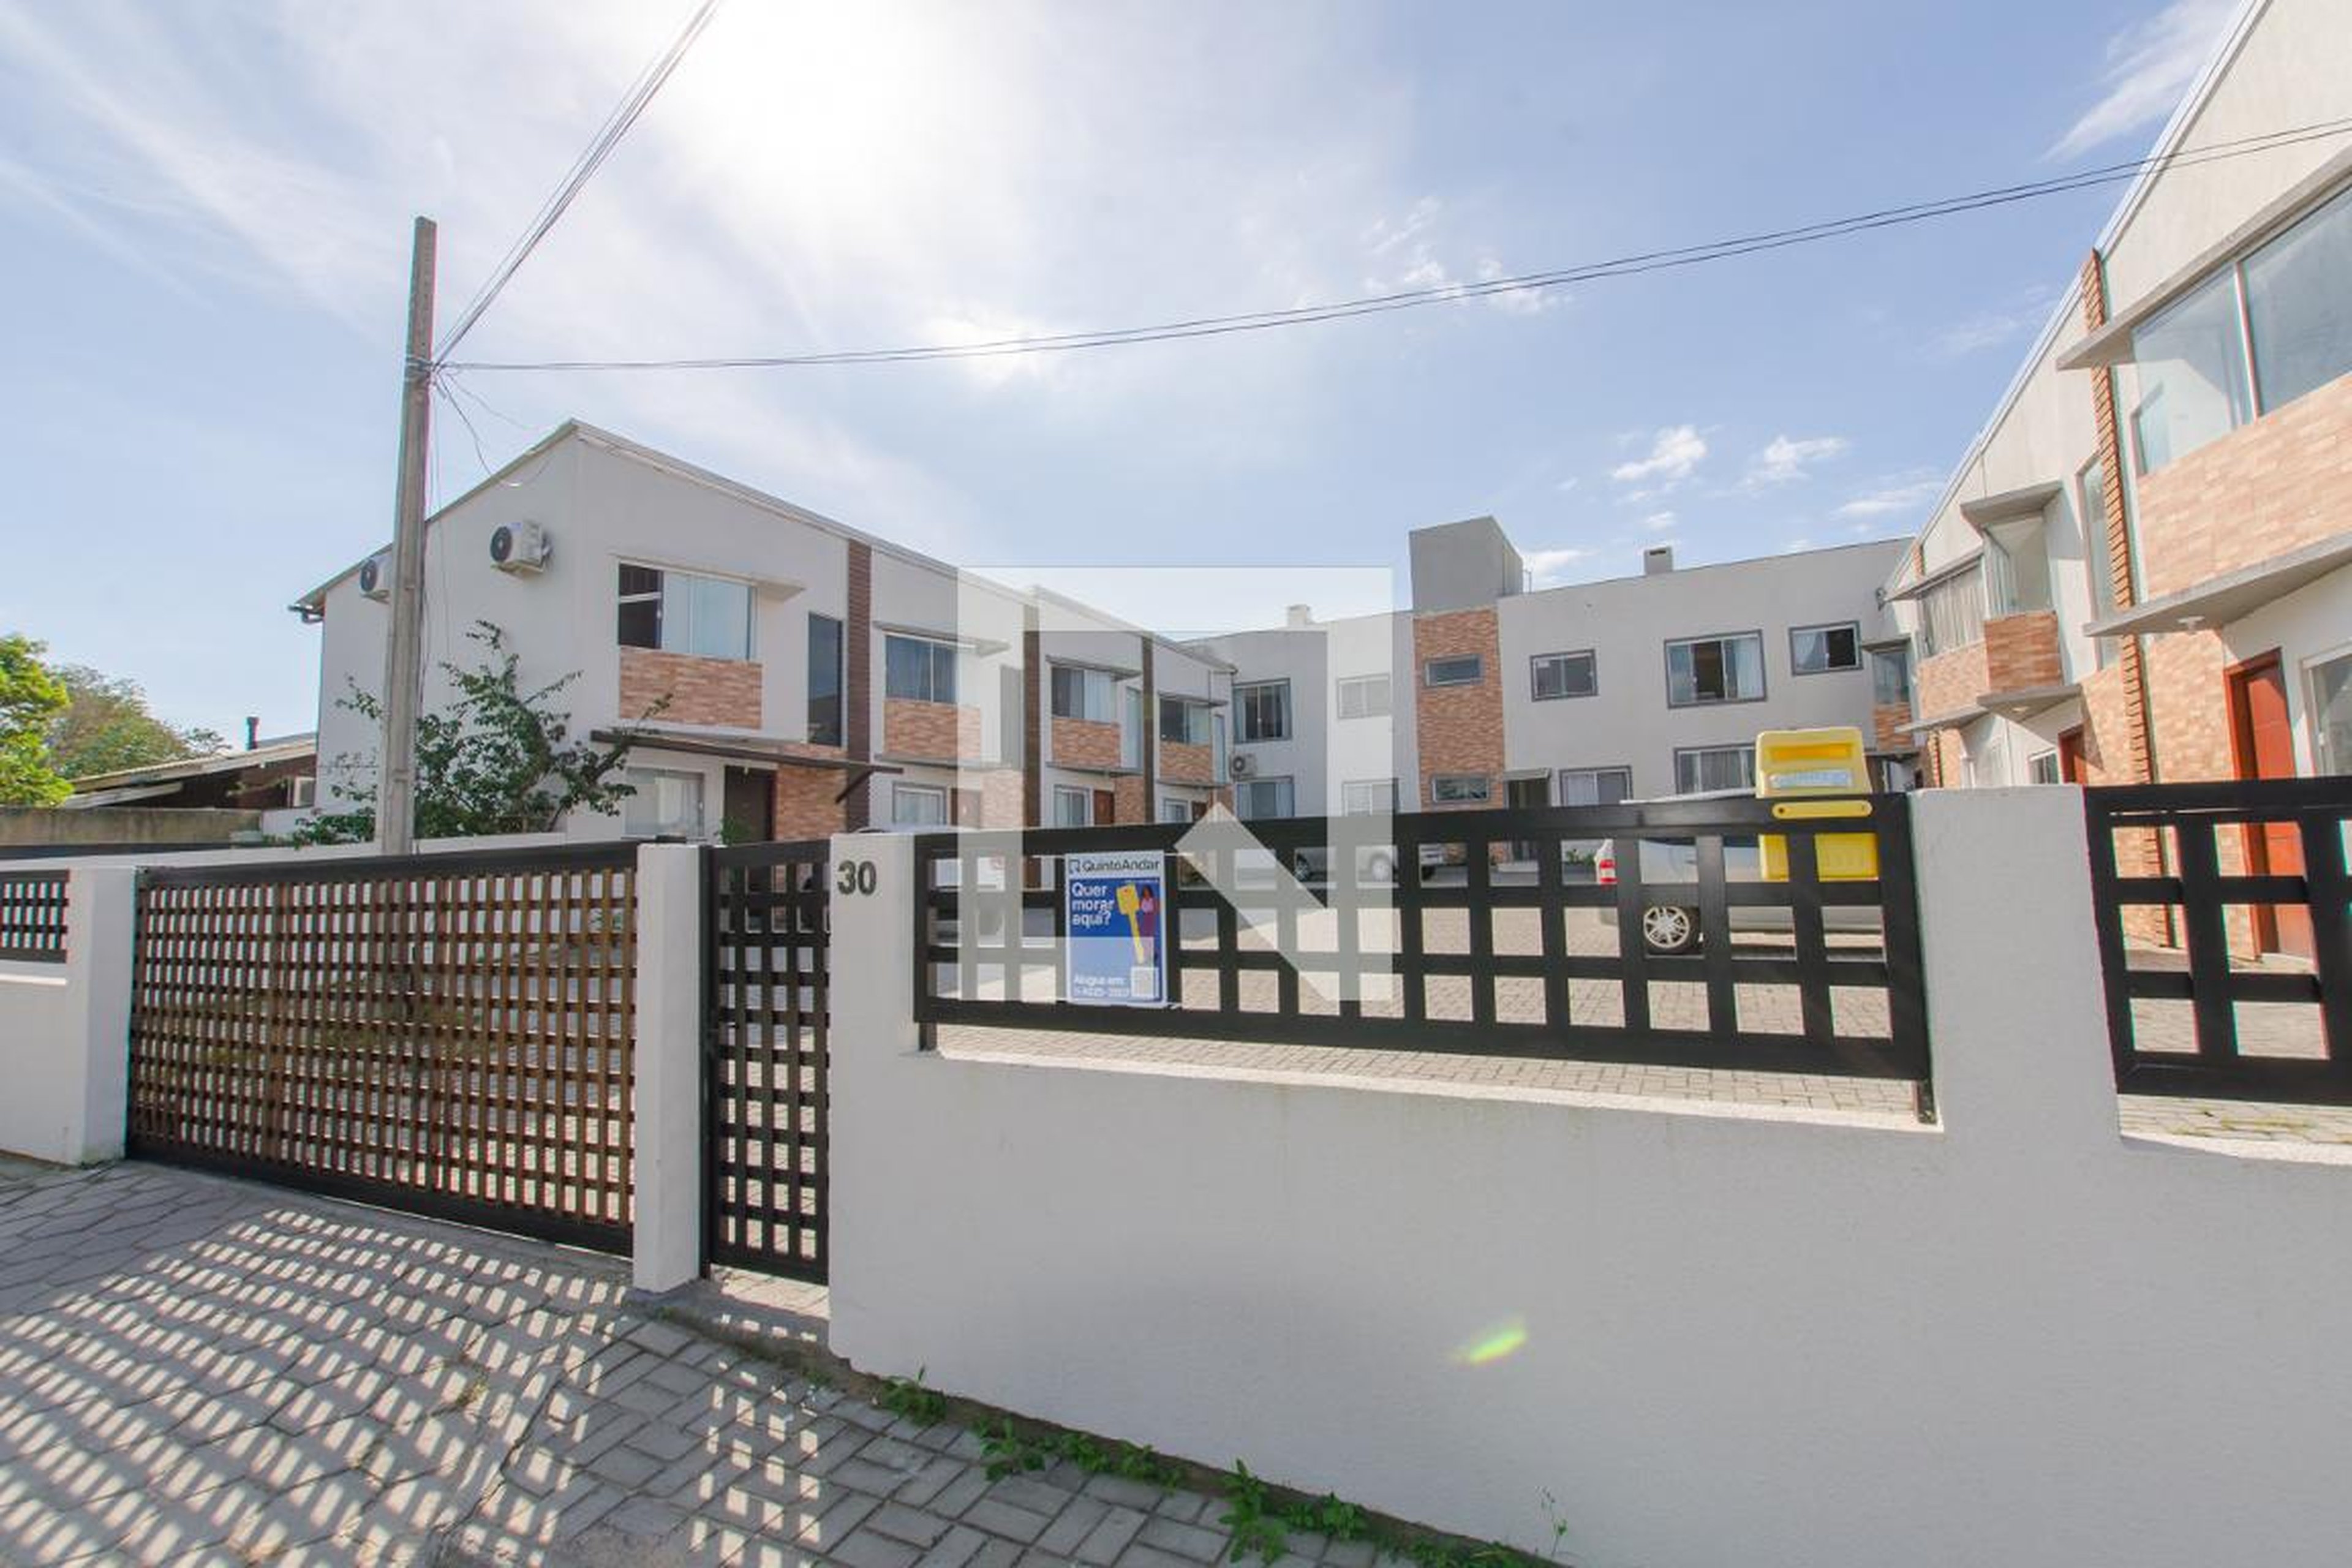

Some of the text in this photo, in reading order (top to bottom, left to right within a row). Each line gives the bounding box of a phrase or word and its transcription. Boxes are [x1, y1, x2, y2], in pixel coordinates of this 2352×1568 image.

[1082, 859, 1160, 872] QuintoAndar
[837, 861, 876, 895] 30
[1072, 882, 1107, 897] Quer
[1072, 899, 1115, 911] morar
[1072, 910, 1112, 928] aqui?
